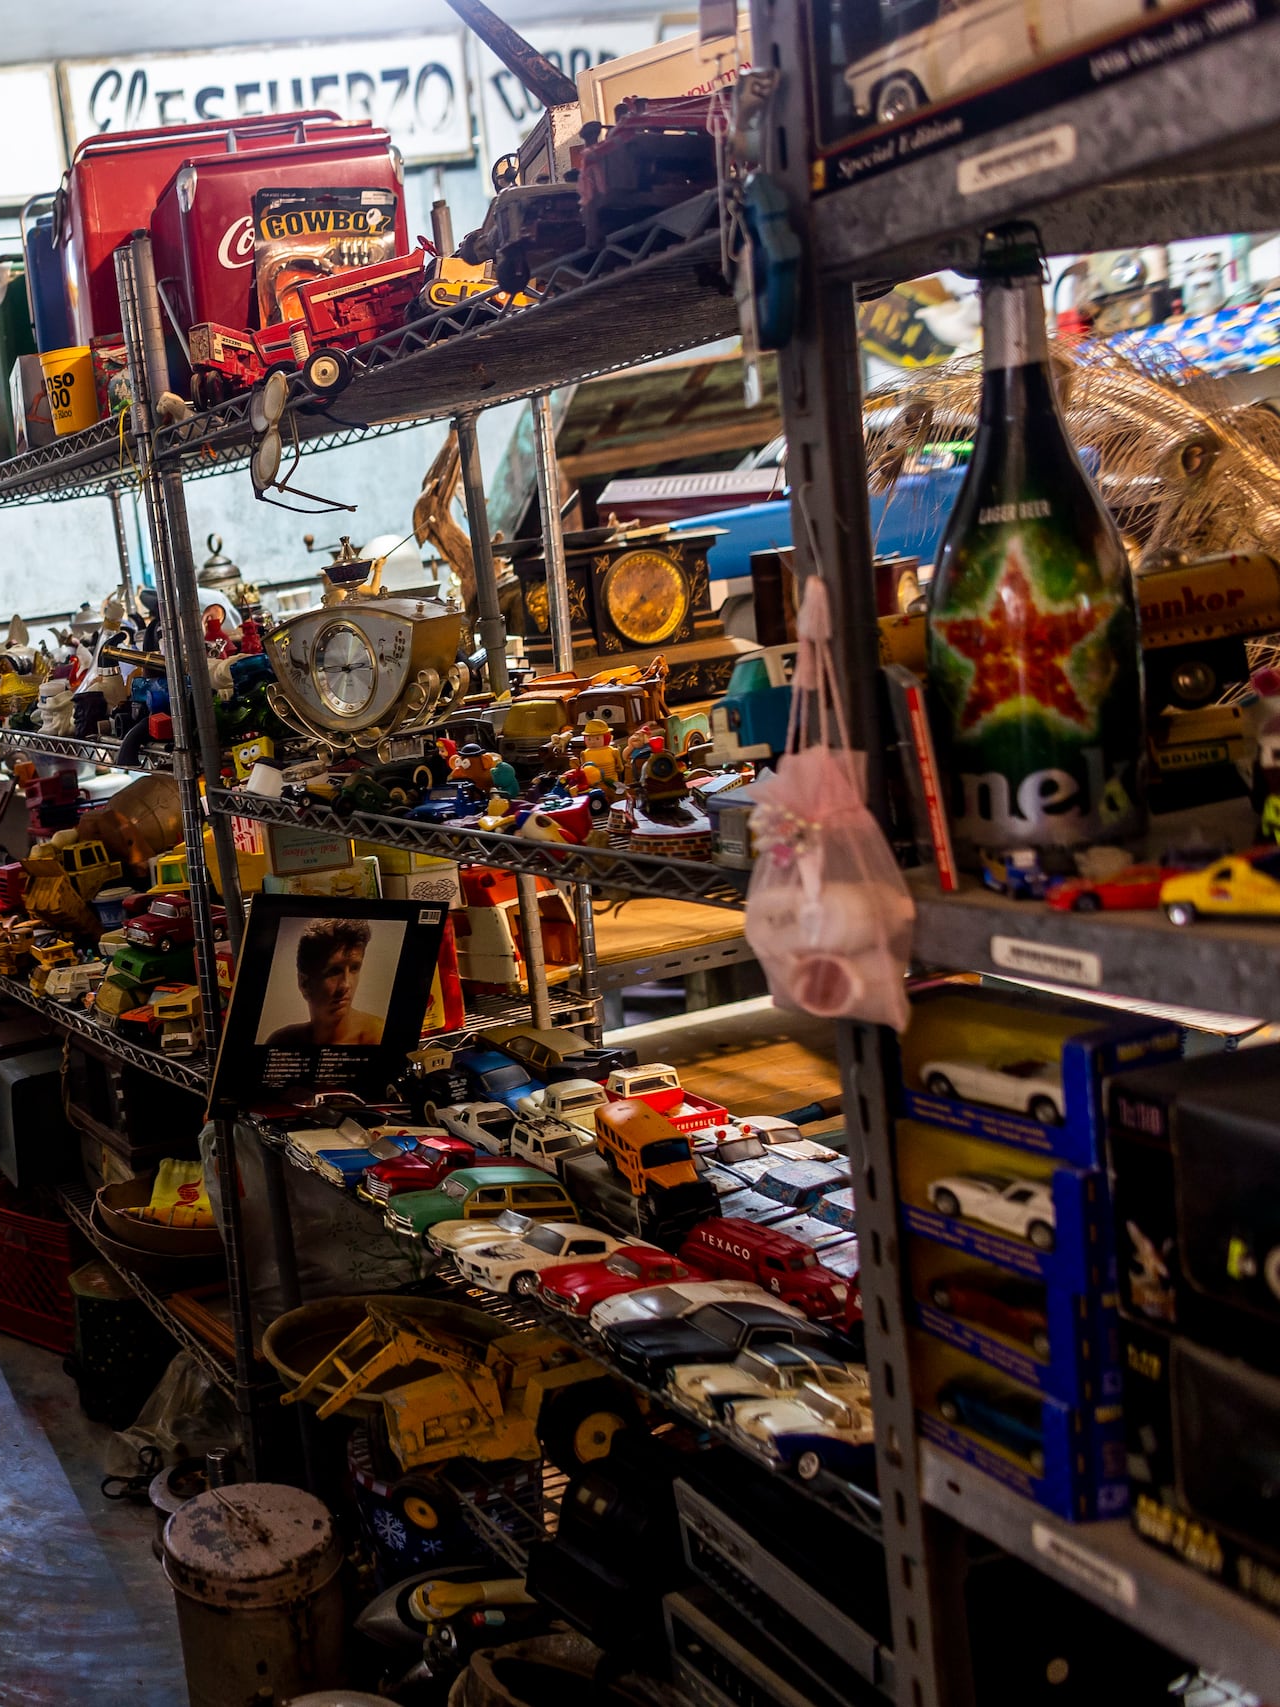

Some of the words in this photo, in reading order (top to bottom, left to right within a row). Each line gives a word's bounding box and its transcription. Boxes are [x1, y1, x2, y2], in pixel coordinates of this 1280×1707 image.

[260, 209, 392, 241] COWBOY
[978, 503, 1017, 525] LAGER
[676, 1117, 717, 1131] CHEVROLET
[700, 1230, 751, 1260] TEXACO
